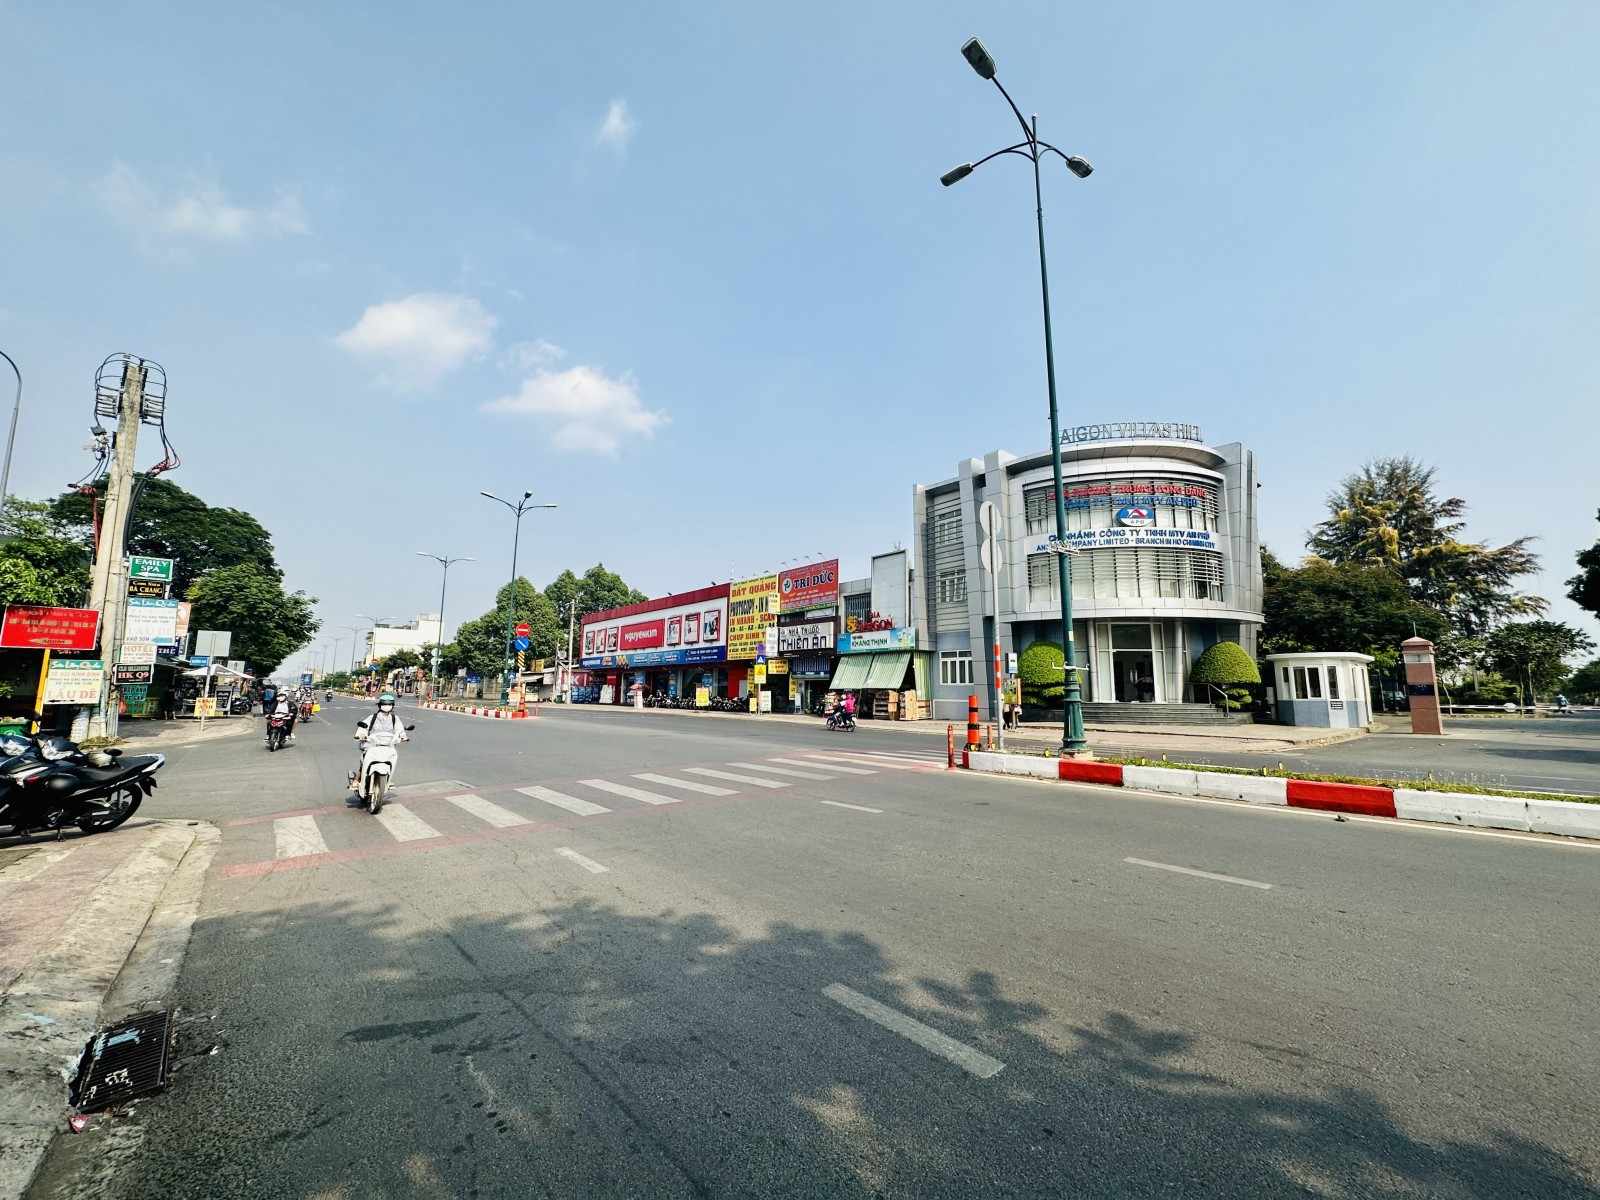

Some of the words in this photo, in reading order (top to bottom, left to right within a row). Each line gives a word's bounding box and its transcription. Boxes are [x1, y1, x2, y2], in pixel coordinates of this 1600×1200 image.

[1059, 424, 1113, 444] AIGON
[1098, 528, 1126, 538] CÔNG
[1129, 529, 1141, 537] TY
[1145, 529, 1167, 537] TNHH
[1098, 537, 1130, 547] LIMITED
[135, 558, 169, 567] EMILY
